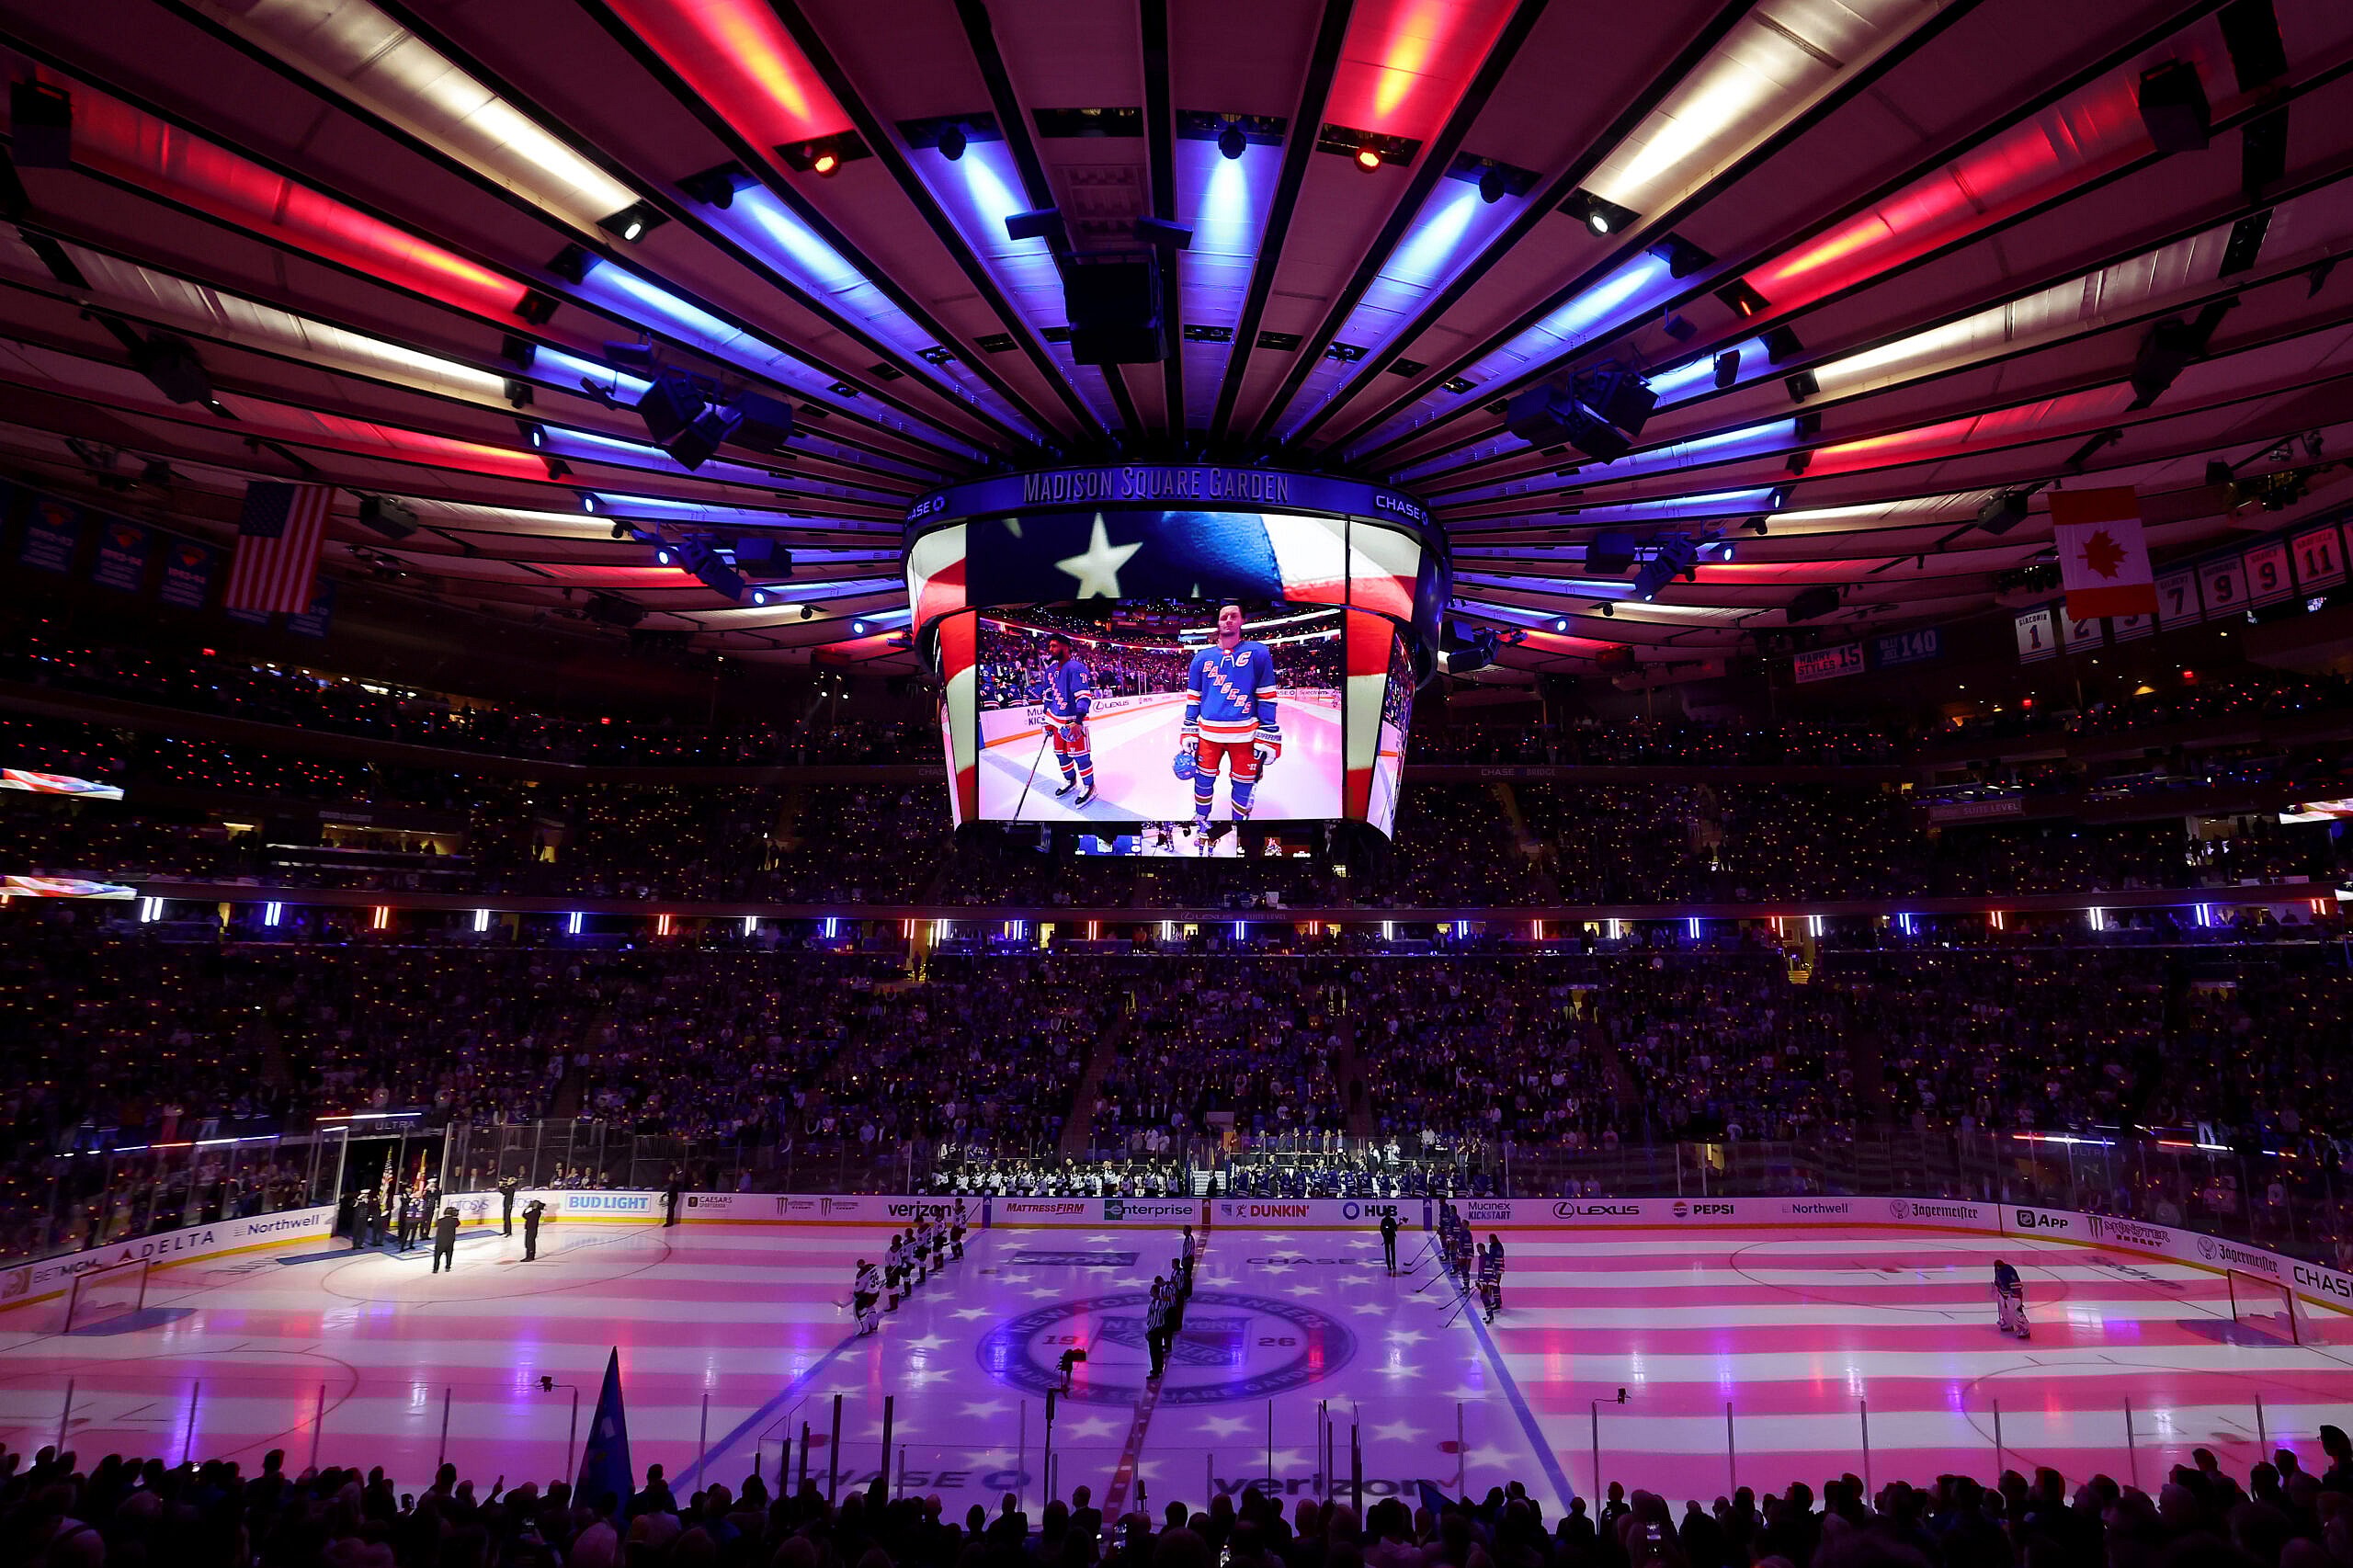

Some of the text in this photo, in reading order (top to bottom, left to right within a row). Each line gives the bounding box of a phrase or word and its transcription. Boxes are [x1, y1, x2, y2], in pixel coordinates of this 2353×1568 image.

[1375, 494, 1420, 520] CHASE
[2302, 545, 2334, 579] 11
[2258, 562, 2278, 590] 9
[2214, 574, 2233, 603] 9
[2167, 586, 2184, 615] 7
[1901, 630, 1938, 657] 140
[2029, 624, 2041, 649] 1
[1235, 651, 1252, 667] C
[1799, 651, 1831, 665] HARRY
[1840, 645, 1861, 667] 15
[1798, 660, 1836, 676] STYLES
[1202, 660, 1253, 714] RANGERS
[1105, 700, 1130, 709] LEXUS
[1481, 767, 1516, 776] CHASE
[374, 1120, 416, 1131] ULTRA
[448, 1198, 490, 1213] Infosys
[569, 1195, 649, 1210] BUD LIGHT
[699, 1196, 733, 1204] CAESARS
[1109, 1203, 1193, 1218] enterprise
[1250, 1204, 1310, 1218] DUNKIN'
[1364, 1205, 1398, 1217] HUB
[1468, 1210, 1511, 1220] KICKSTART
[1576, 1205, 1640, 1215] LEXUS
[1693, 1204, 1734, 1215] PEPSI
[1792, 1202, 1848, 1214] Northwell
[247, 1214, 320, 1236] Northwell
[2104, 1221, 2171, 1243] MONSTER
[141, 1230, 216, 1258] DELTA
[33, 1257, 98, 1284] BETMGM
[2293, 1266, 2353, 1299] CHAS
[1073, 1296, 1144, 1310] YOR
[1199, 1295, 1330, 1328] RANGERS
[1105, 1320, 1148, 1330] NE
[1041, 1335, 1079, 1346] 19
[1257, 1337, 1297, 1347] 26
